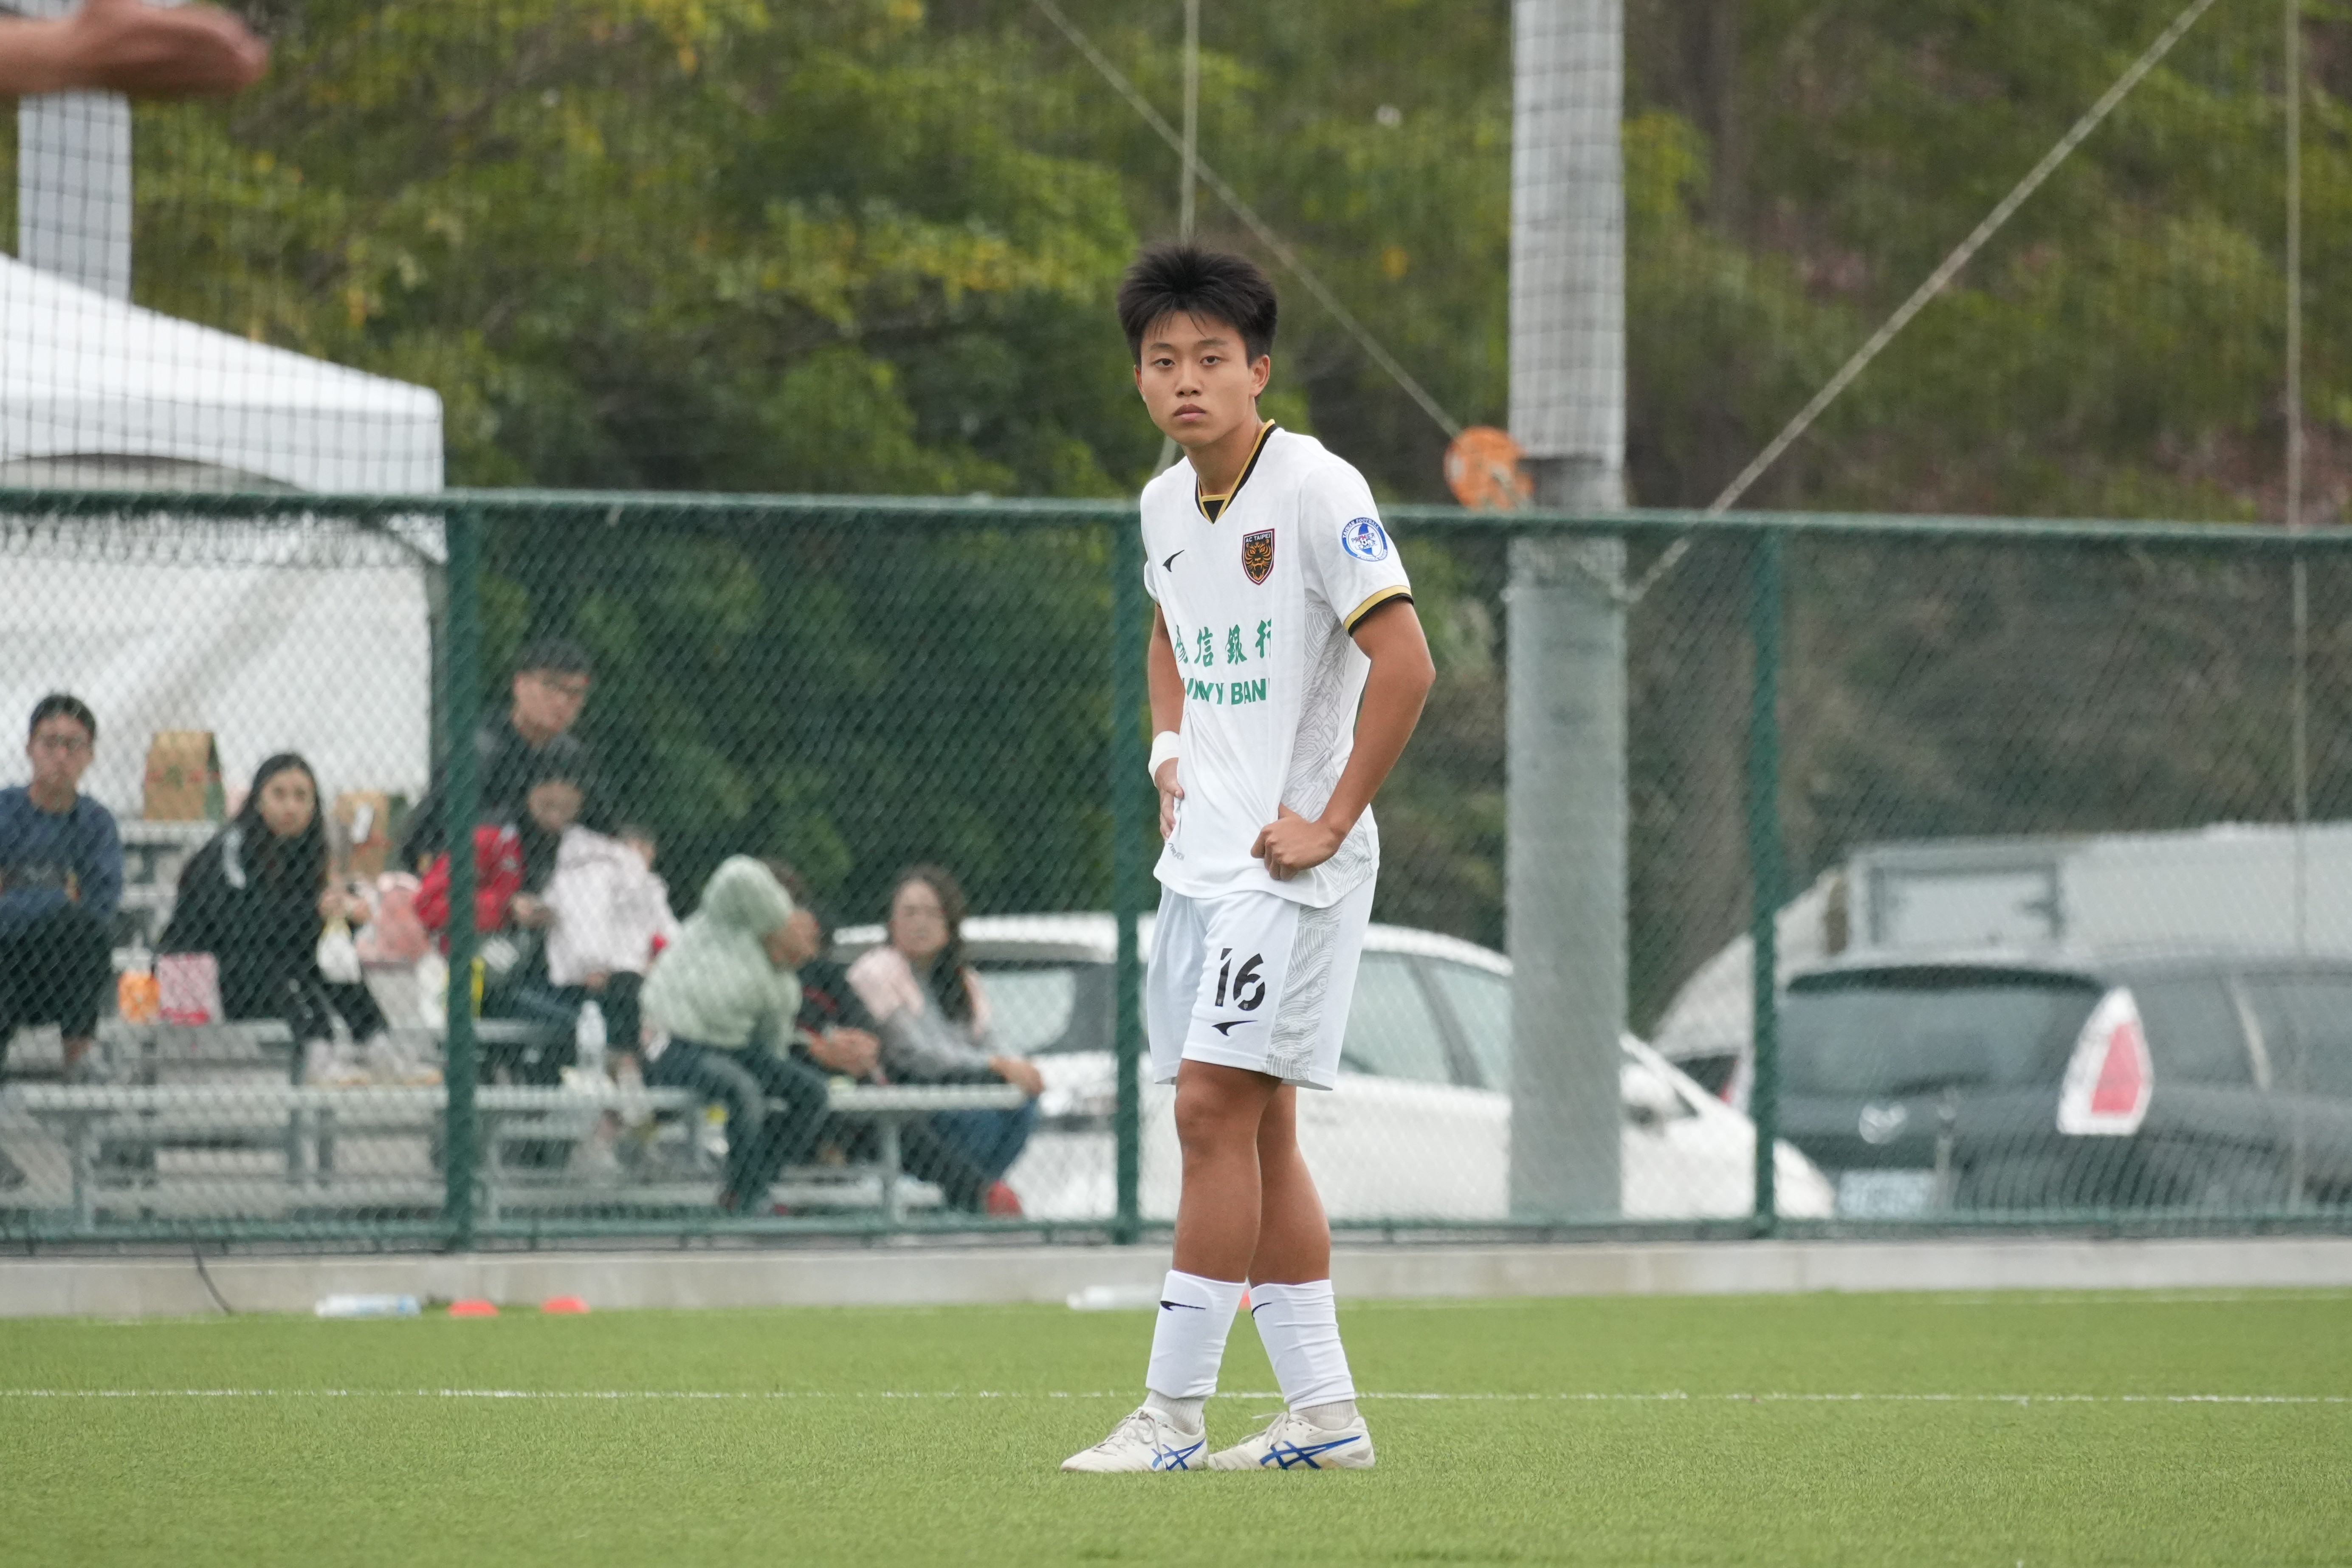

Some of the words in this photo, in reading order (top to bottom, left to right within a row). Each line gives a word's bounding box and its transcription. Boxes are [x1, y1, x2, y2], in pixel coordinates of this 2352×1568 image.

[1254, 533, 1271, 541] TAIPEI
[1342, 520, 1355, 539] TAIWAN
[1356, 518, 1380, 530] FOOTBALL
[1231, 678, 1270, 705] BAN
[1215, 948, 1265, 1011] 16
